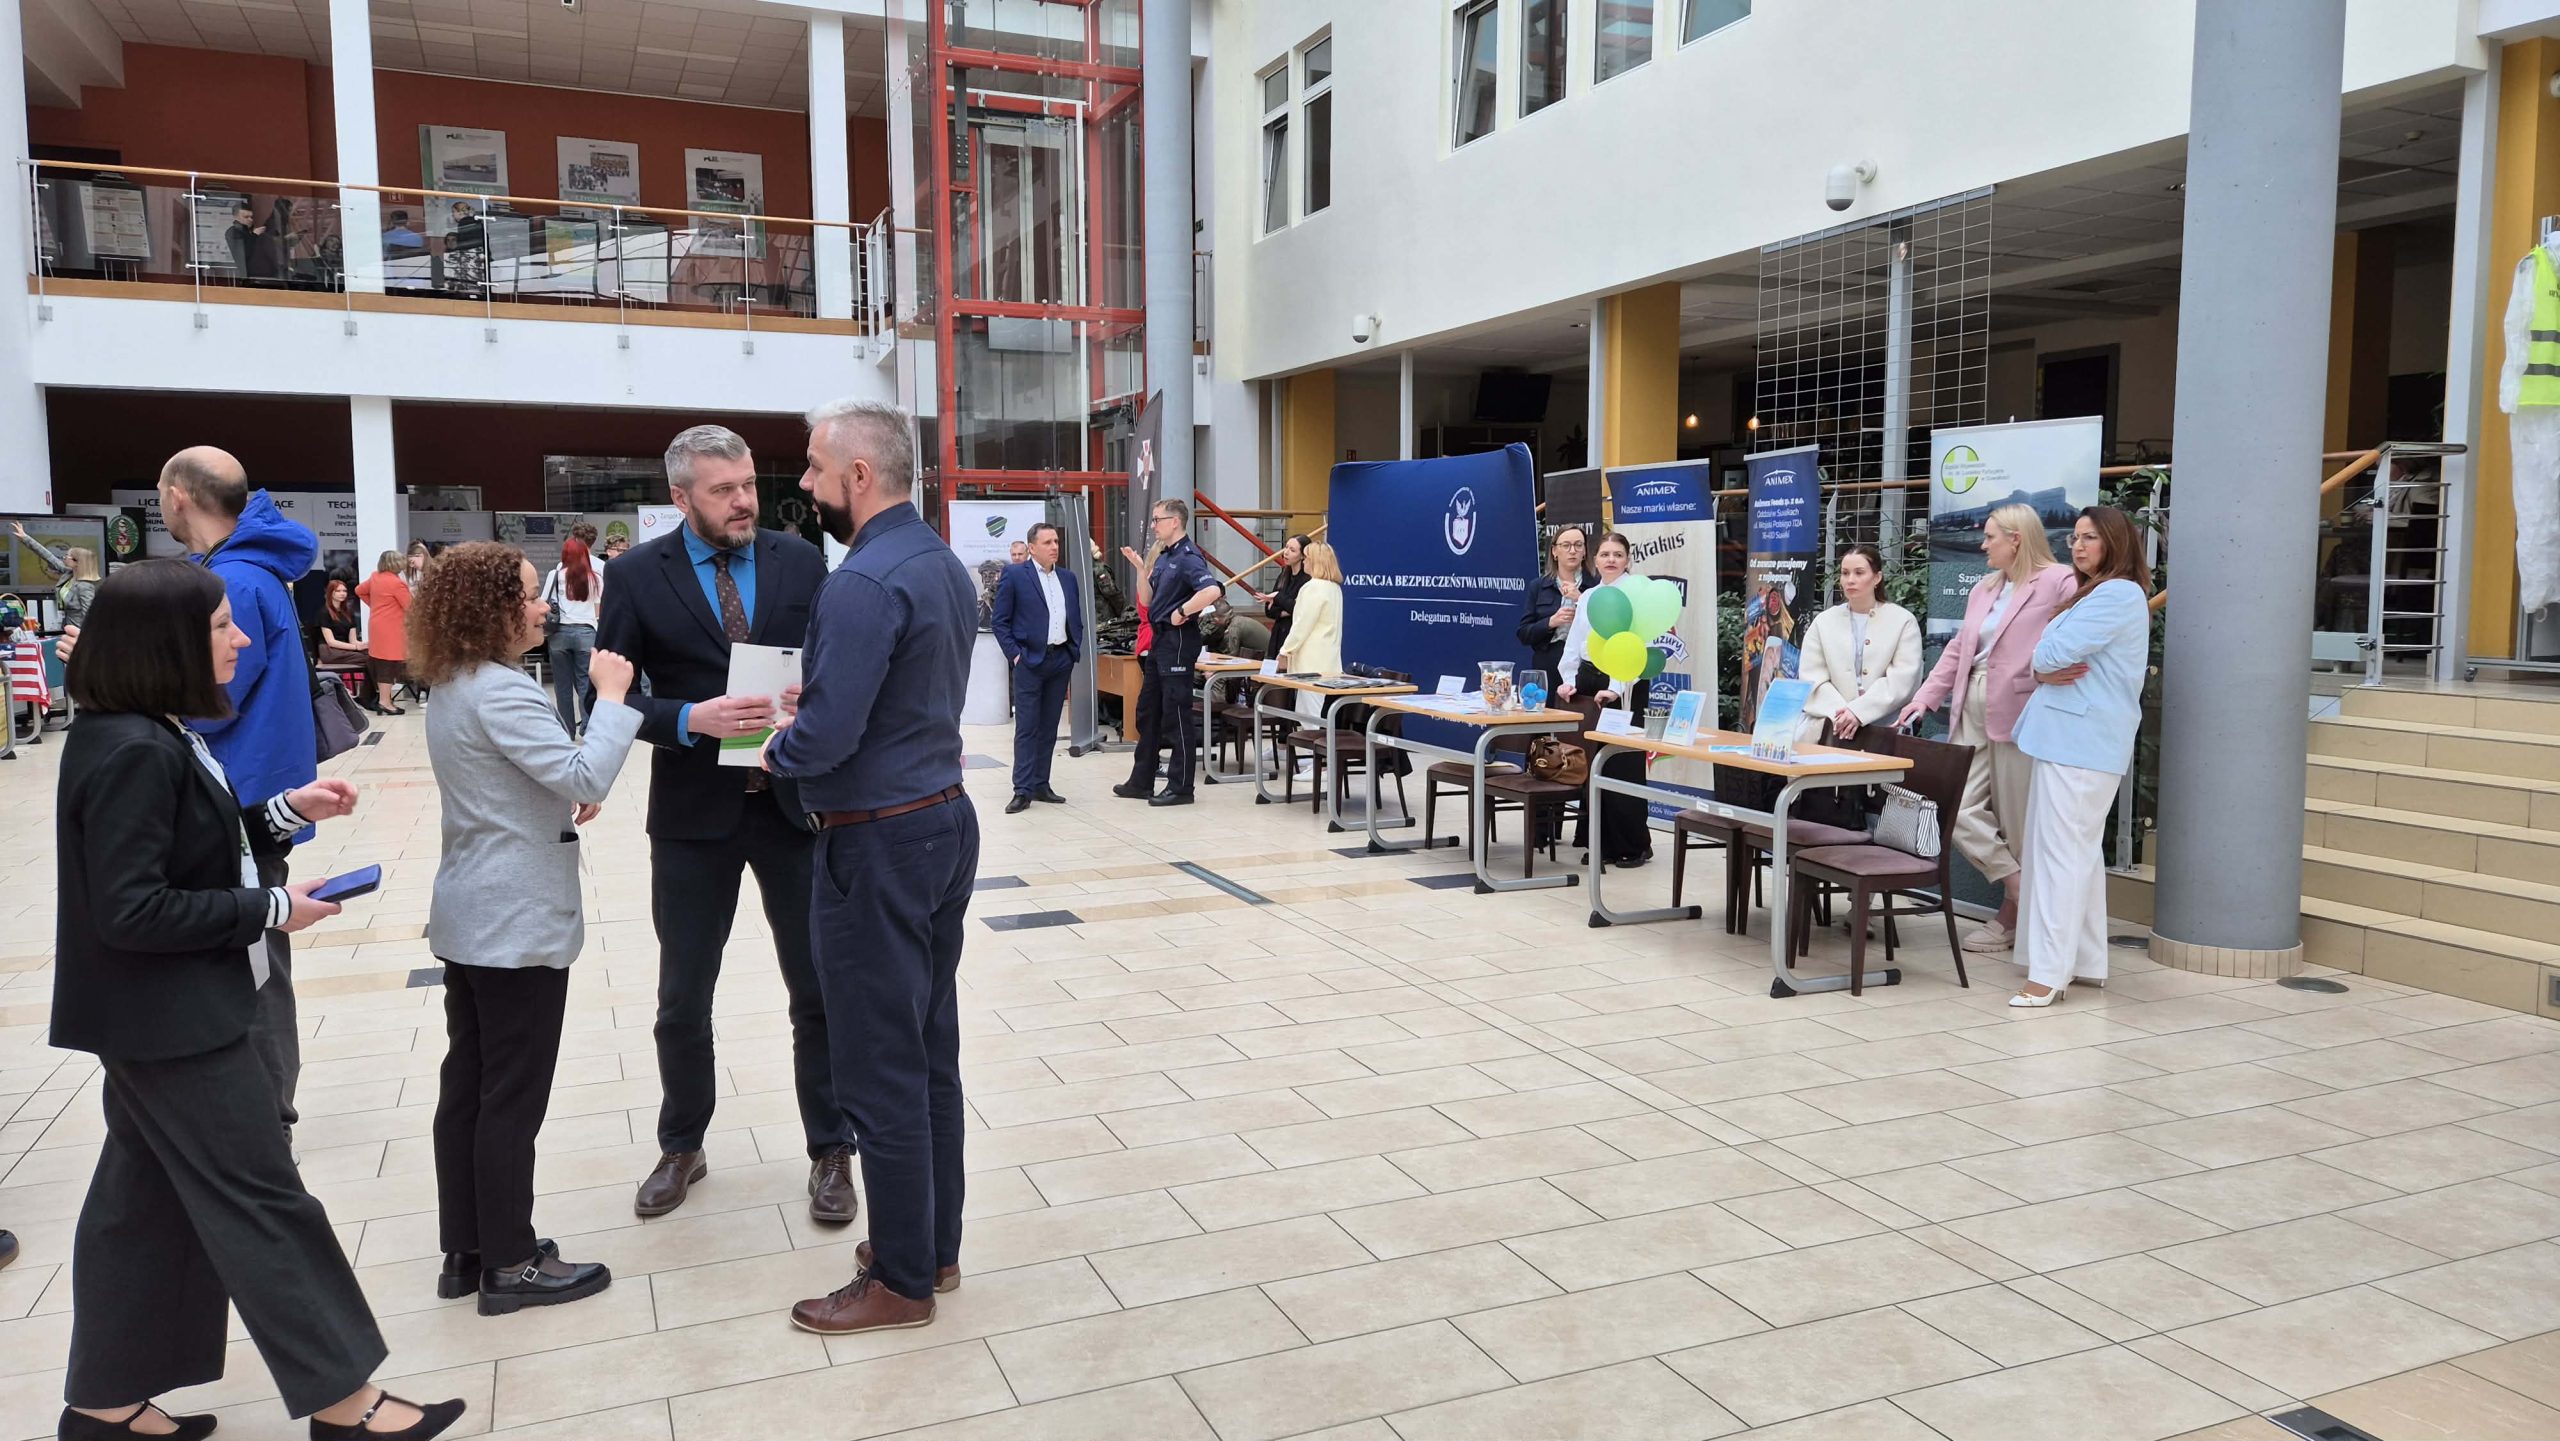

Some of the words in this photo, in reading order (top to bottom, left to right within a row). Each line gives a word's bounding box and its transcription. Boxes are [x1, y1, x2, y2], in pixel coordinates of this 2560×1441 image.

[1765, 475, 1794, 486] ANIMEX
[1636, 486, 1677, 496] ANIMEX
[138, 498, 160, 507] LICE
[274, 500, 295, 510] ĄCE
[327, 500, 356, 509] TECH
[1620, 504, 1642, 514] Nasze
[1643, 502, 1666, 513] marki
[1666, 501, 1697, 512] własne:
[1631, 530, 1686, 563] Krakus
[1344, 574, 1393, 587] AGENCJA
[1395, 573, 1477, 589] BEZPIECZEŃSTWA
[1478, 576, 1525, 592] WEWNĘTRZNEGO
[1958, 573, 1982, 585] Szpit
[1943, 586, 1957, 596] im.
[1410, 610, 1451, 625] Delegatura
[1452, 615, 1459, 624] w
[1648, 691, 1675, 702] MORLIN
